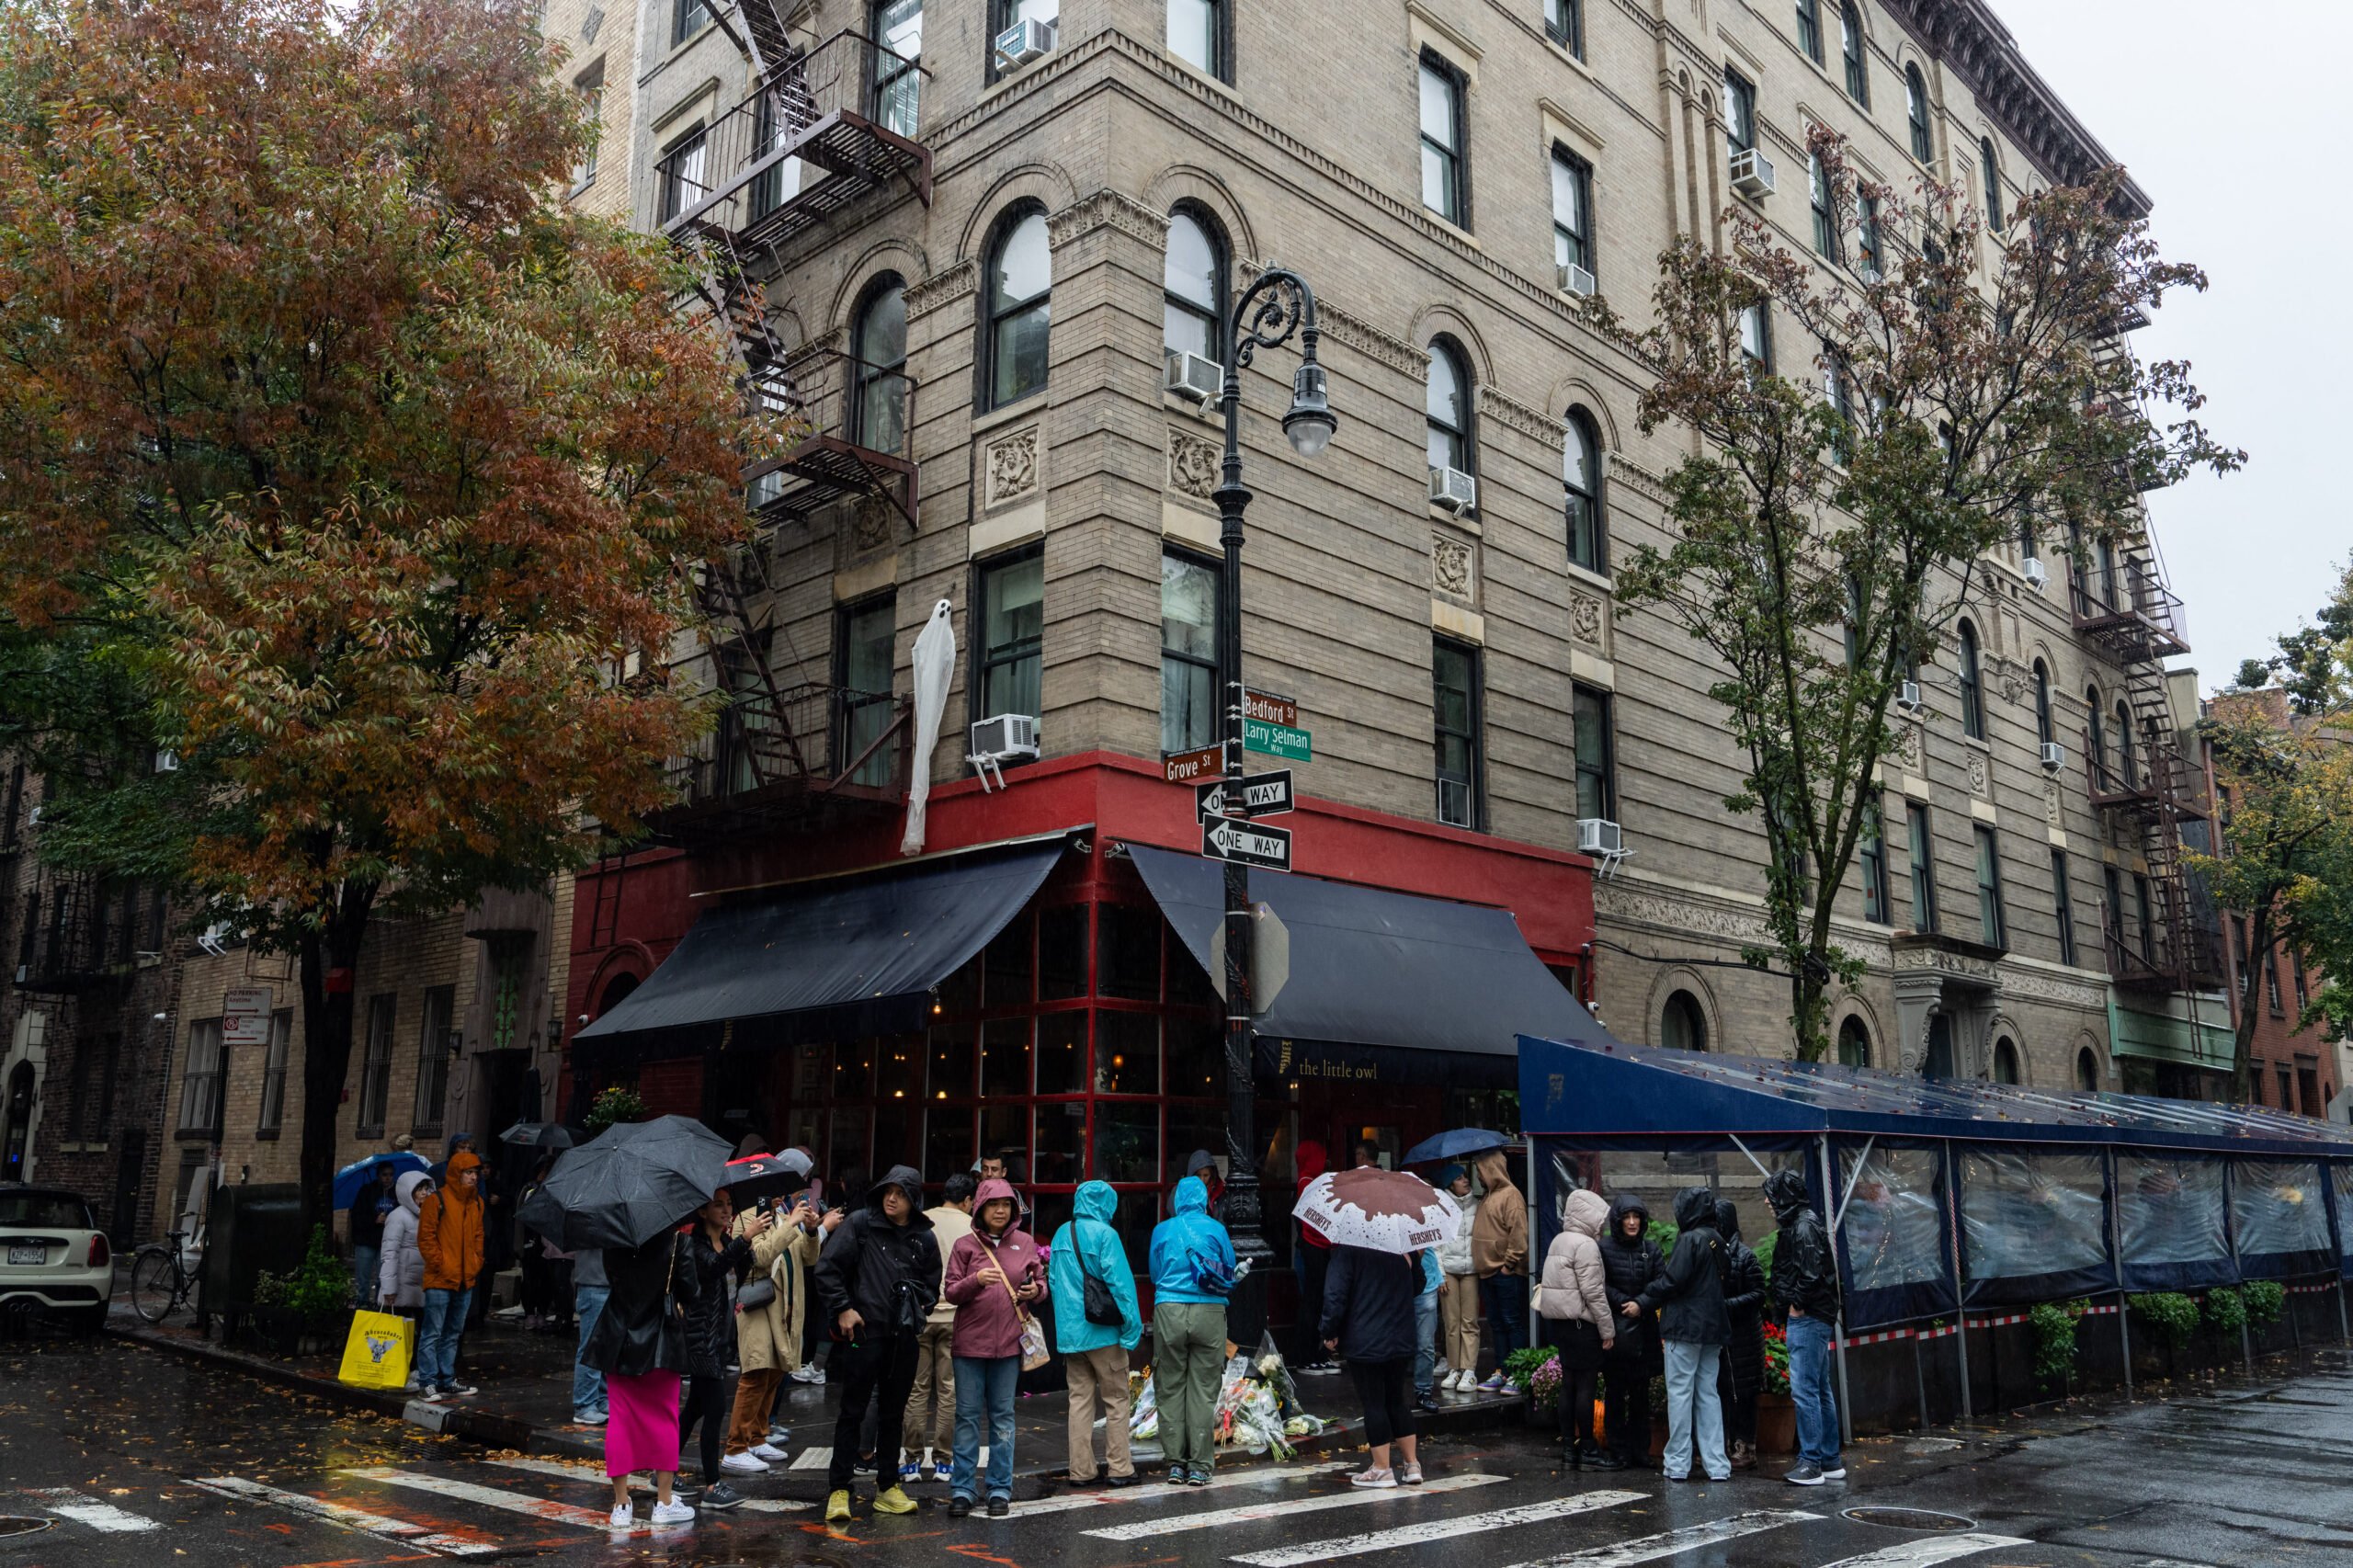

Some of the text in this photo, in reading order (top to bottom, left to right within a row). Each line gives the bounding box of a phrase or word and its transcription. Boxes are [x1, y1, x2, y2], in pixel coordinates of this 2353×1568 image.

[1245, 696, 1294, 723] Bedford St
[1245, 722, 1308, 749] Larry Selman
[1270, 744, 1283, 756] Way
[1167, 754, 1211, 780] Grove St
[1250, 784, 1279, 804] WAY
[1217, 830, 1279, 857] ONE WAY
[1299, 1058, 1378, 1080] the little owl
